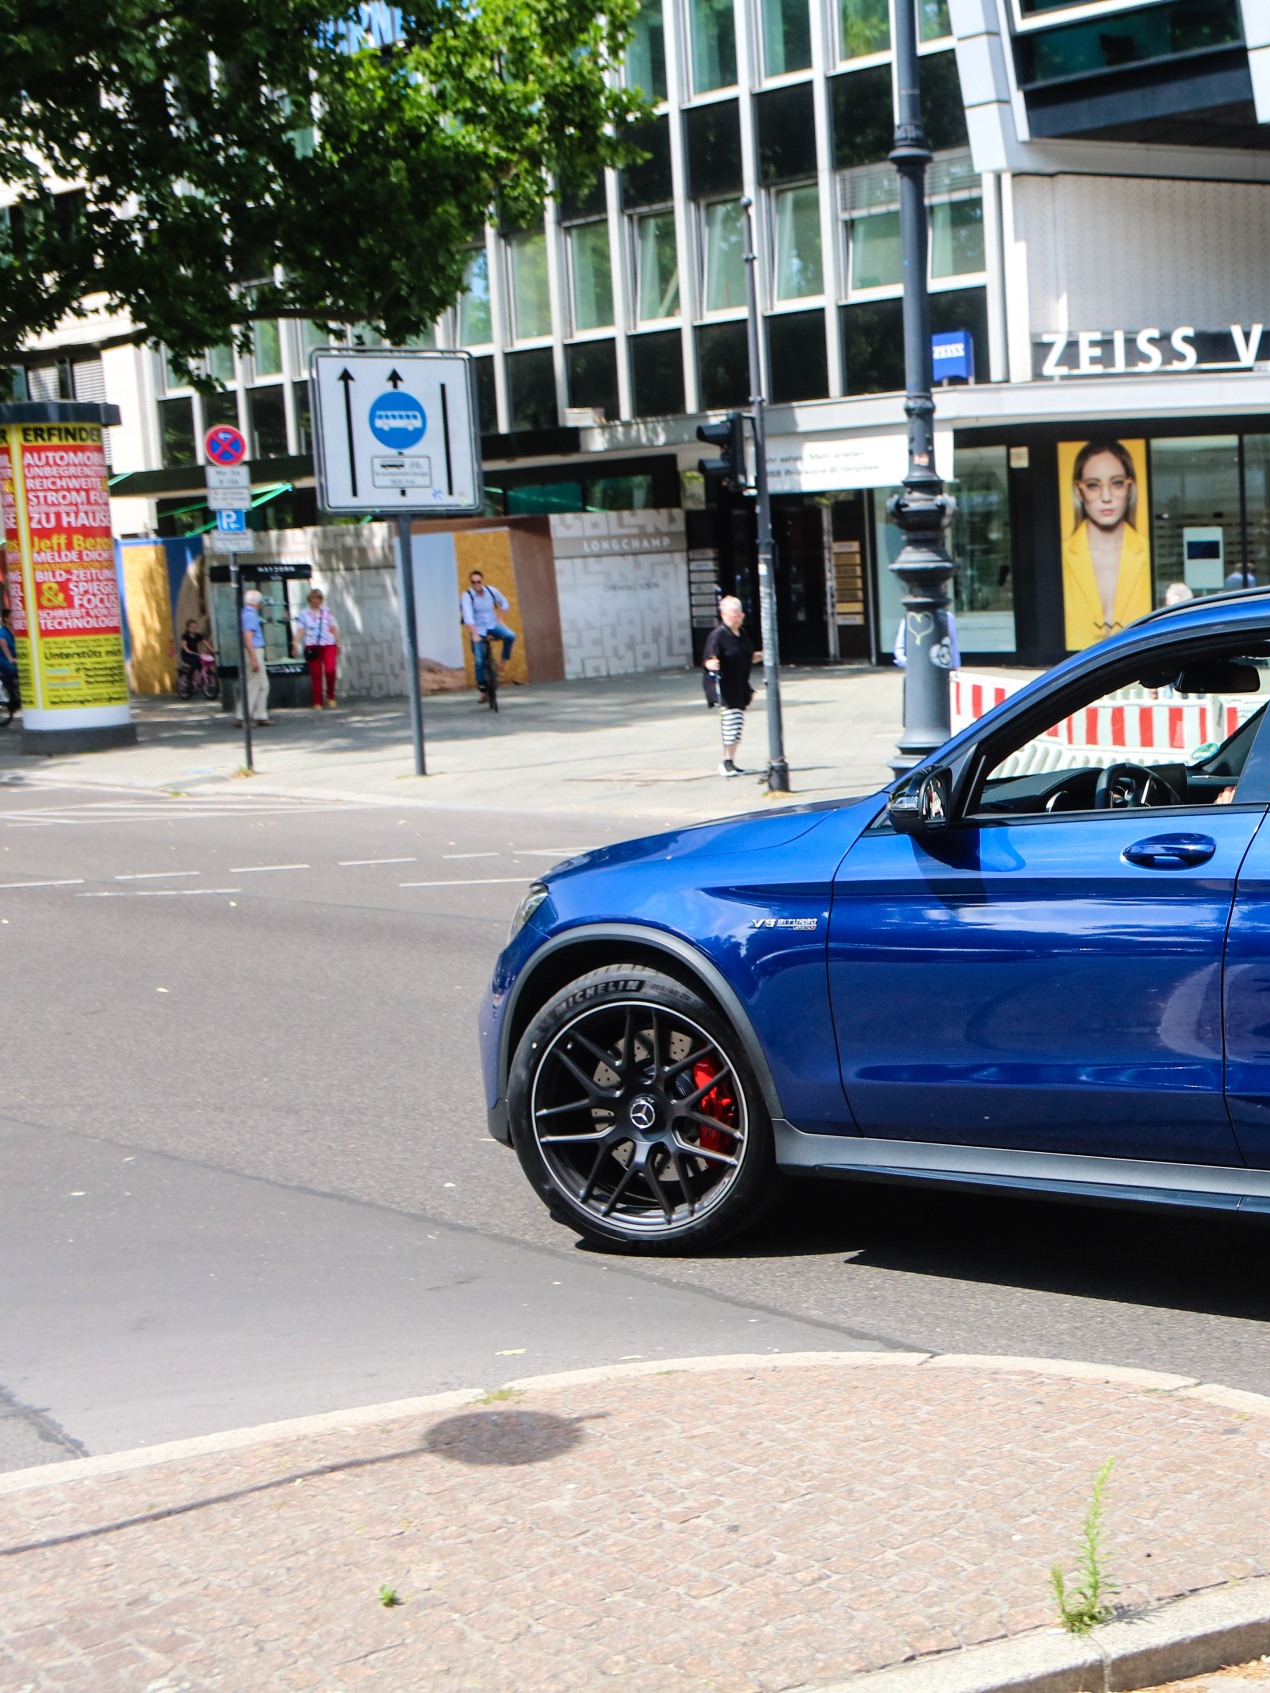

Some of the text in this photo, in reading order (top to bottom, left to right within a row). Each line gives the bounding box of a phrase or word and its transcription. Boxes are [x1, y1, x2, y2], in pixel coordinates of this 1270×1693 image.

[932, 343, 965, 359] ZEISS
[1042, 326, 1198, 376] ZEISS
[22, 427, 101, 443] ERFINDE
[27, 490, 87, 506] STROM
[30, 512, 56, 529] ZU
[32, 534, 68, 553] Jeff
[583, 536, 671, 552] LONGCHAMP
[33, 550, 80, 563] MELDE
[41, 582, 67, 608] &
[777, 918, 818, 926] BITURBO
[554, 979, 642, 1016] MICHELIN
